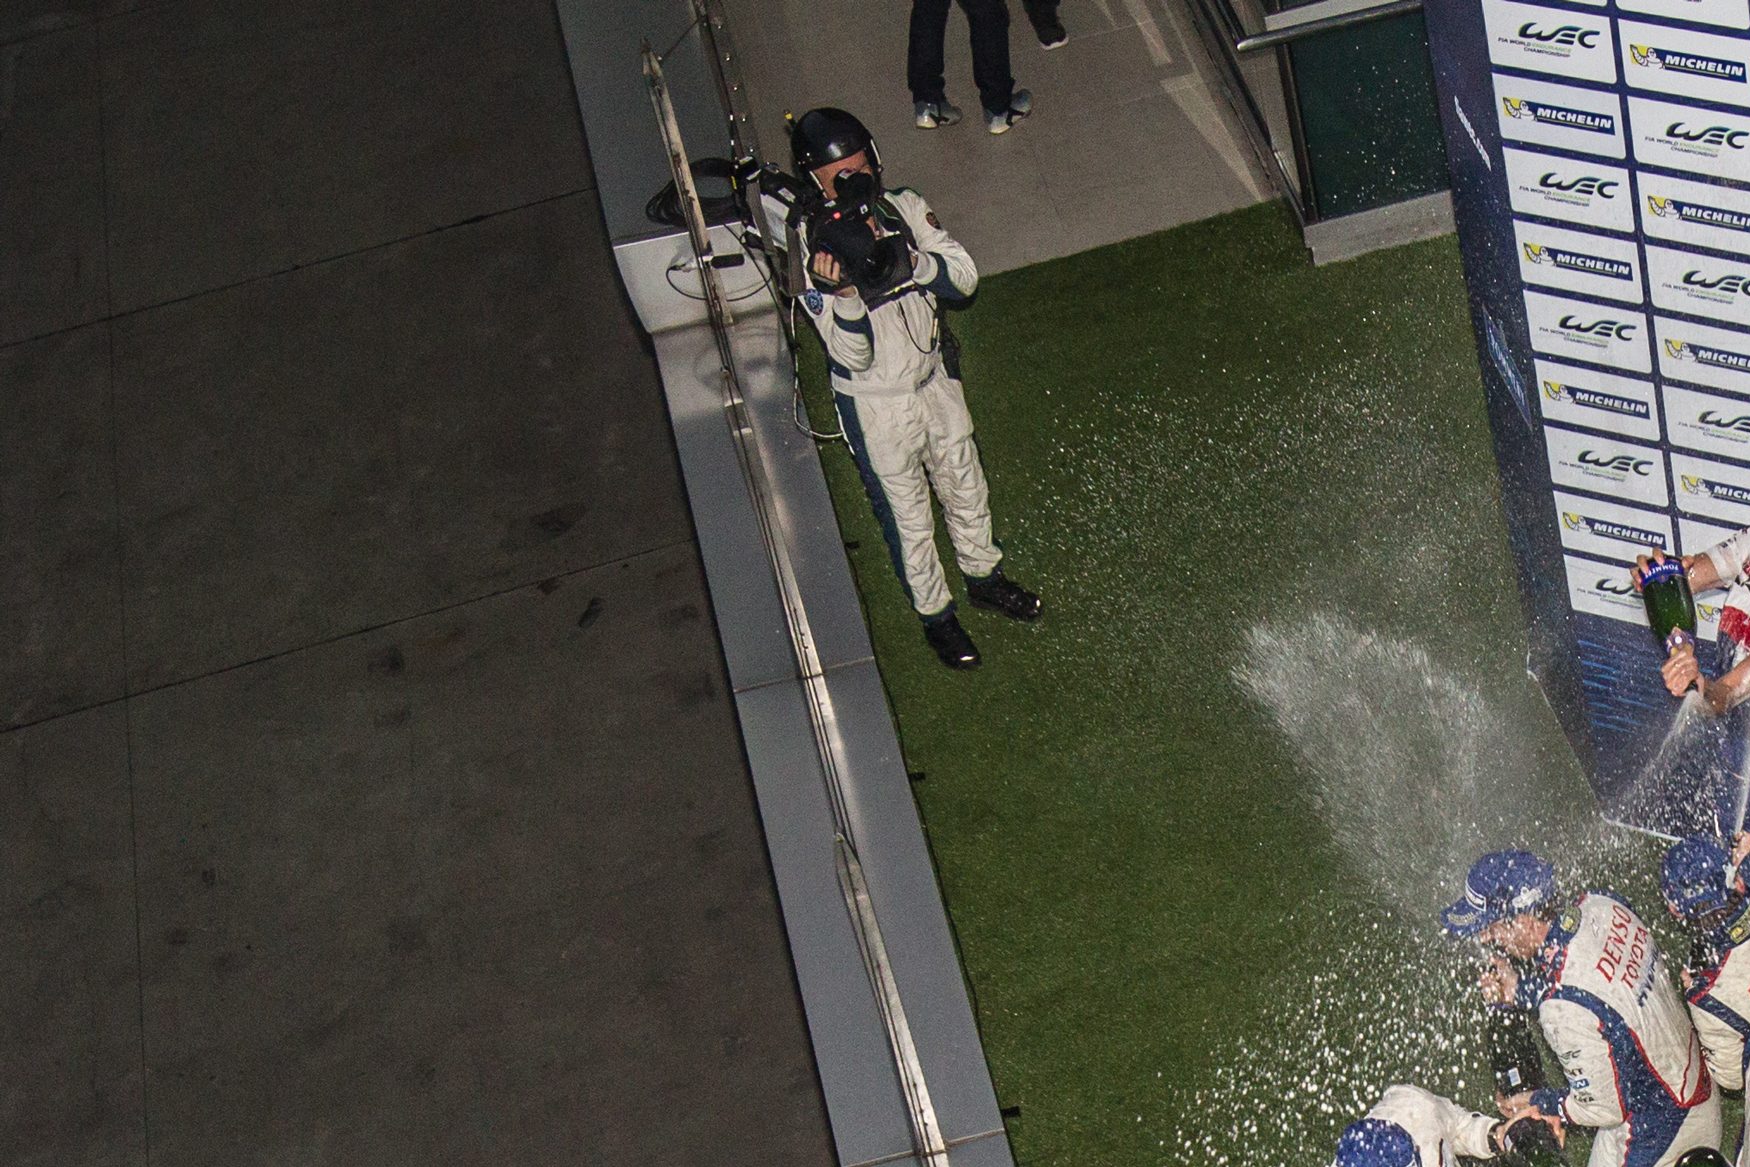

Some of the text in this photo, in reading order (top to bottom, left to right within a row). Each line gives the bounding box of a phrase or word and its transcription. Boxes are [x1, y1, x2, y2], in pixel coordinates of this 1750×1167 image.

[1519, 22, 1600, 48] WEC
[1665, 54, 1743, 76] MICHELIN
[1538, 107, 1611, 129] MICHELIN
[1666, 122, 1749, 149] WEC
[1539, 172, 1618, 198] WEC
[1557, 252, 1628, 275] MICHELIN
[1559, 315, 1636, 341] WEC
[1576, 391, 1646, 414] MICHELIN
[1578, 450, 1653, 475] WEC
[1594, 522, 1662, 545] MICHELIN
[1596, 904, 1632, 983] DENSO
[1621, 926, 1649, 988] TOYOTA
